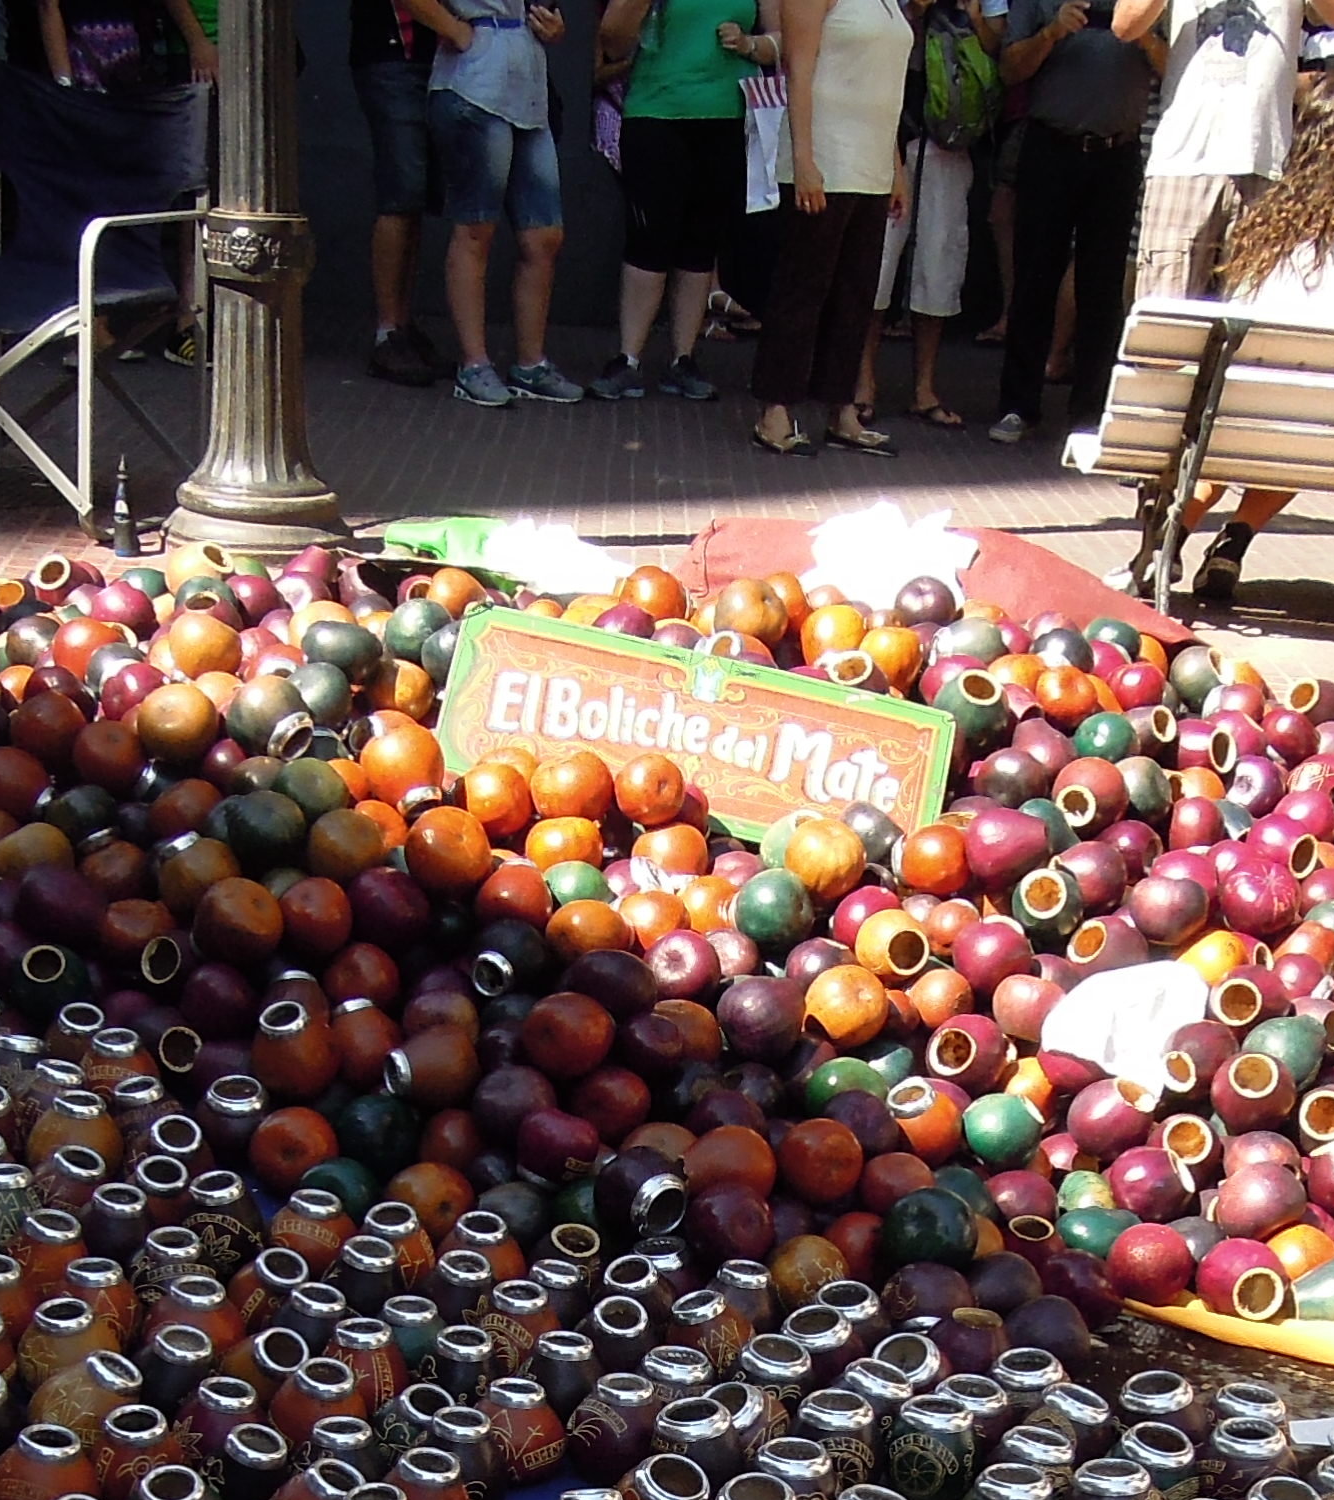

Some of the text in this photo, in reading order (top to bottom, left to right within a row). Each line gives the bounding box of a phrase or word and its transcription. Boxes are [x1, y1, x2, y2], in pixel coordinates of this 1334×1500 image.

[487, 671, 899, 811] El Boliche del Mate
